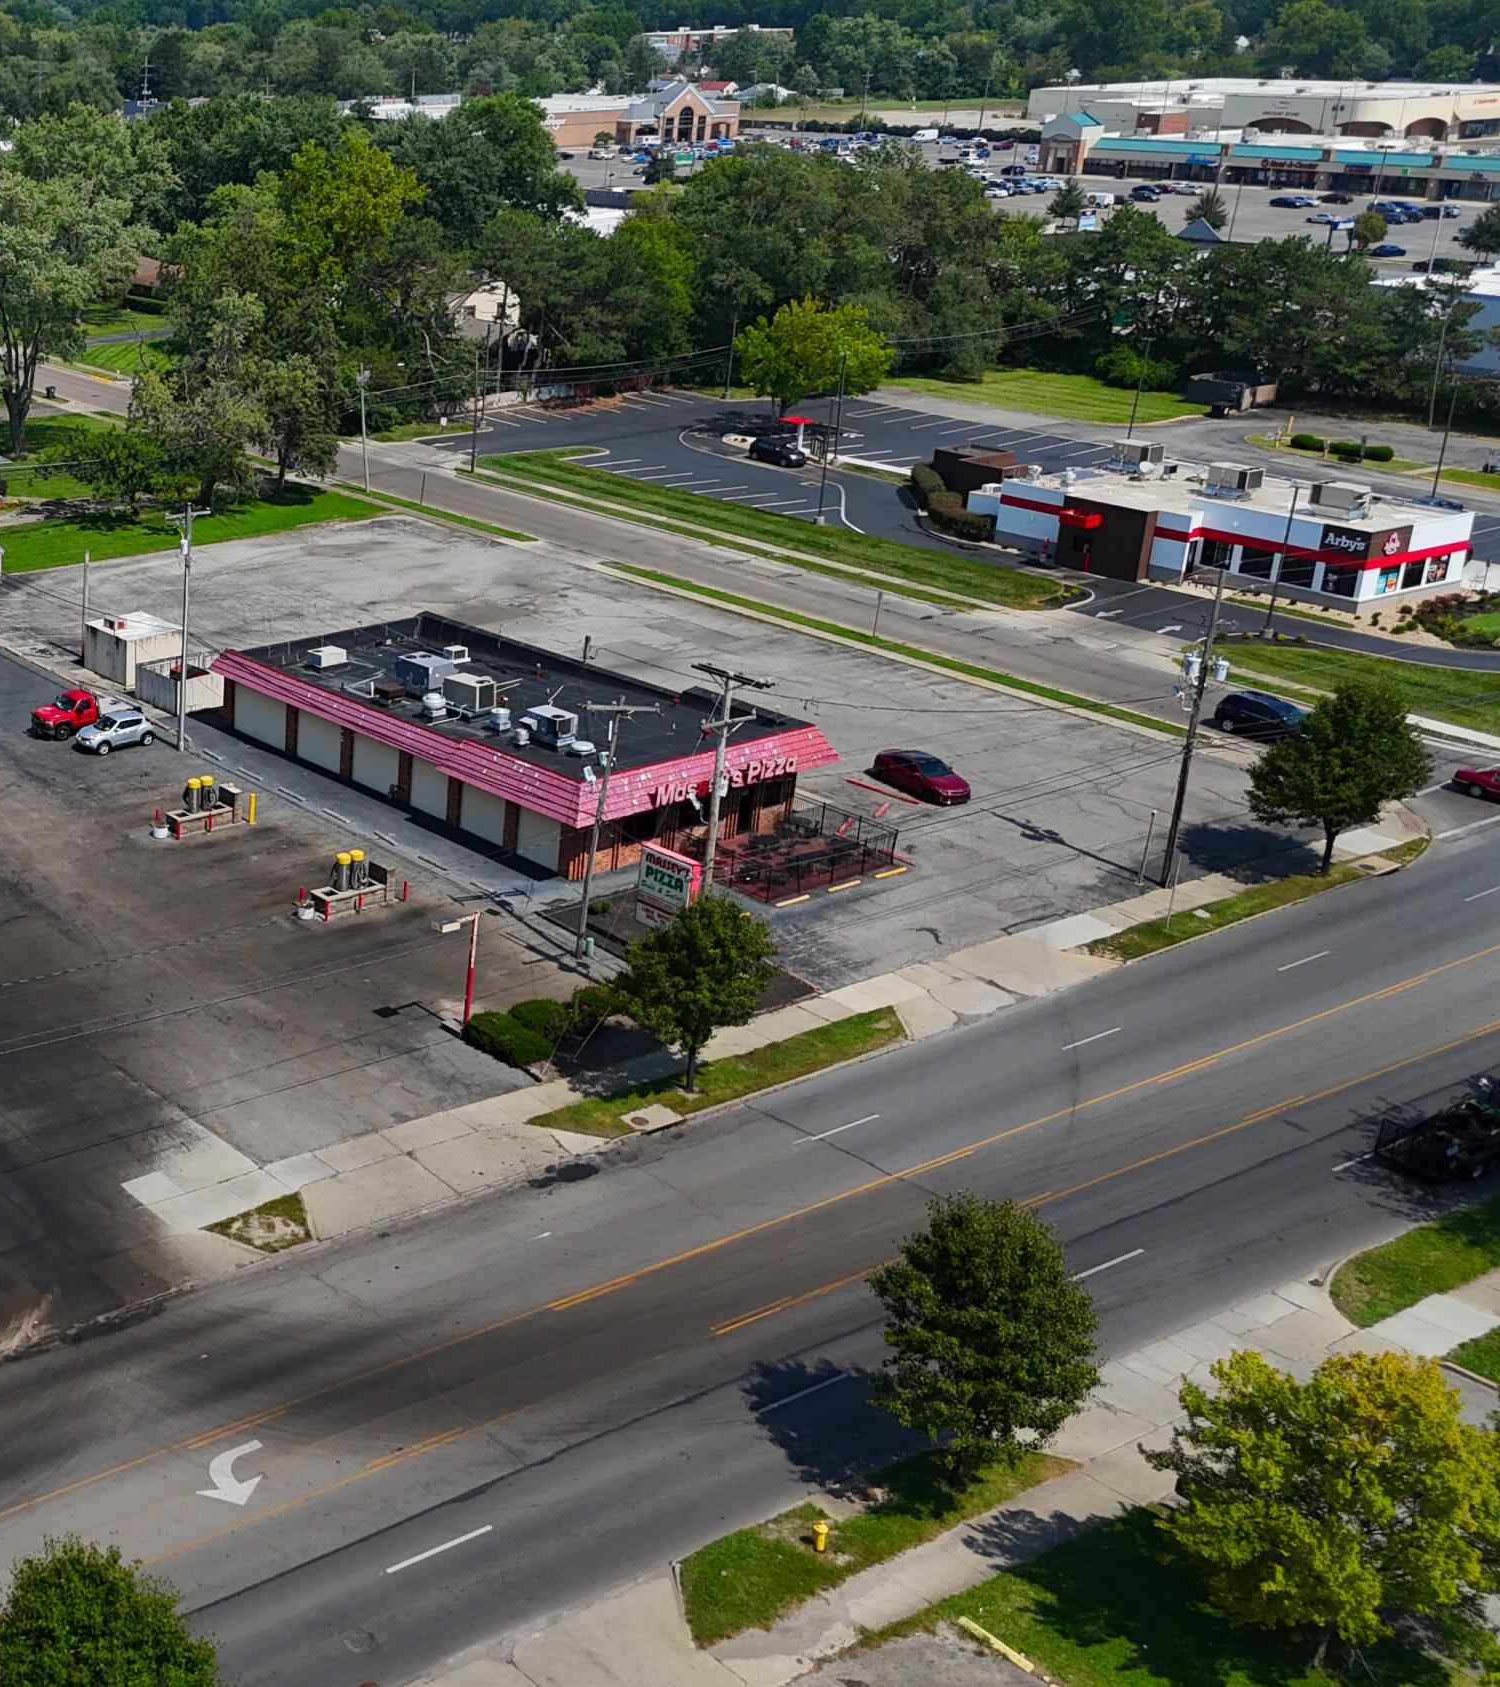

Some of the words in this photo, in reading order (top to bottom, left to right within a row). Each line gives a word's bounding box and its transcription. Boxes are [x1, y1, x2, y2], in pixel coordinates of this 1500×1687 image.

[1324, 532, 1366, 552] Arby's
[745, 756, 797, 785] Pizza
[644, 864, 684, 893] PIZZA
